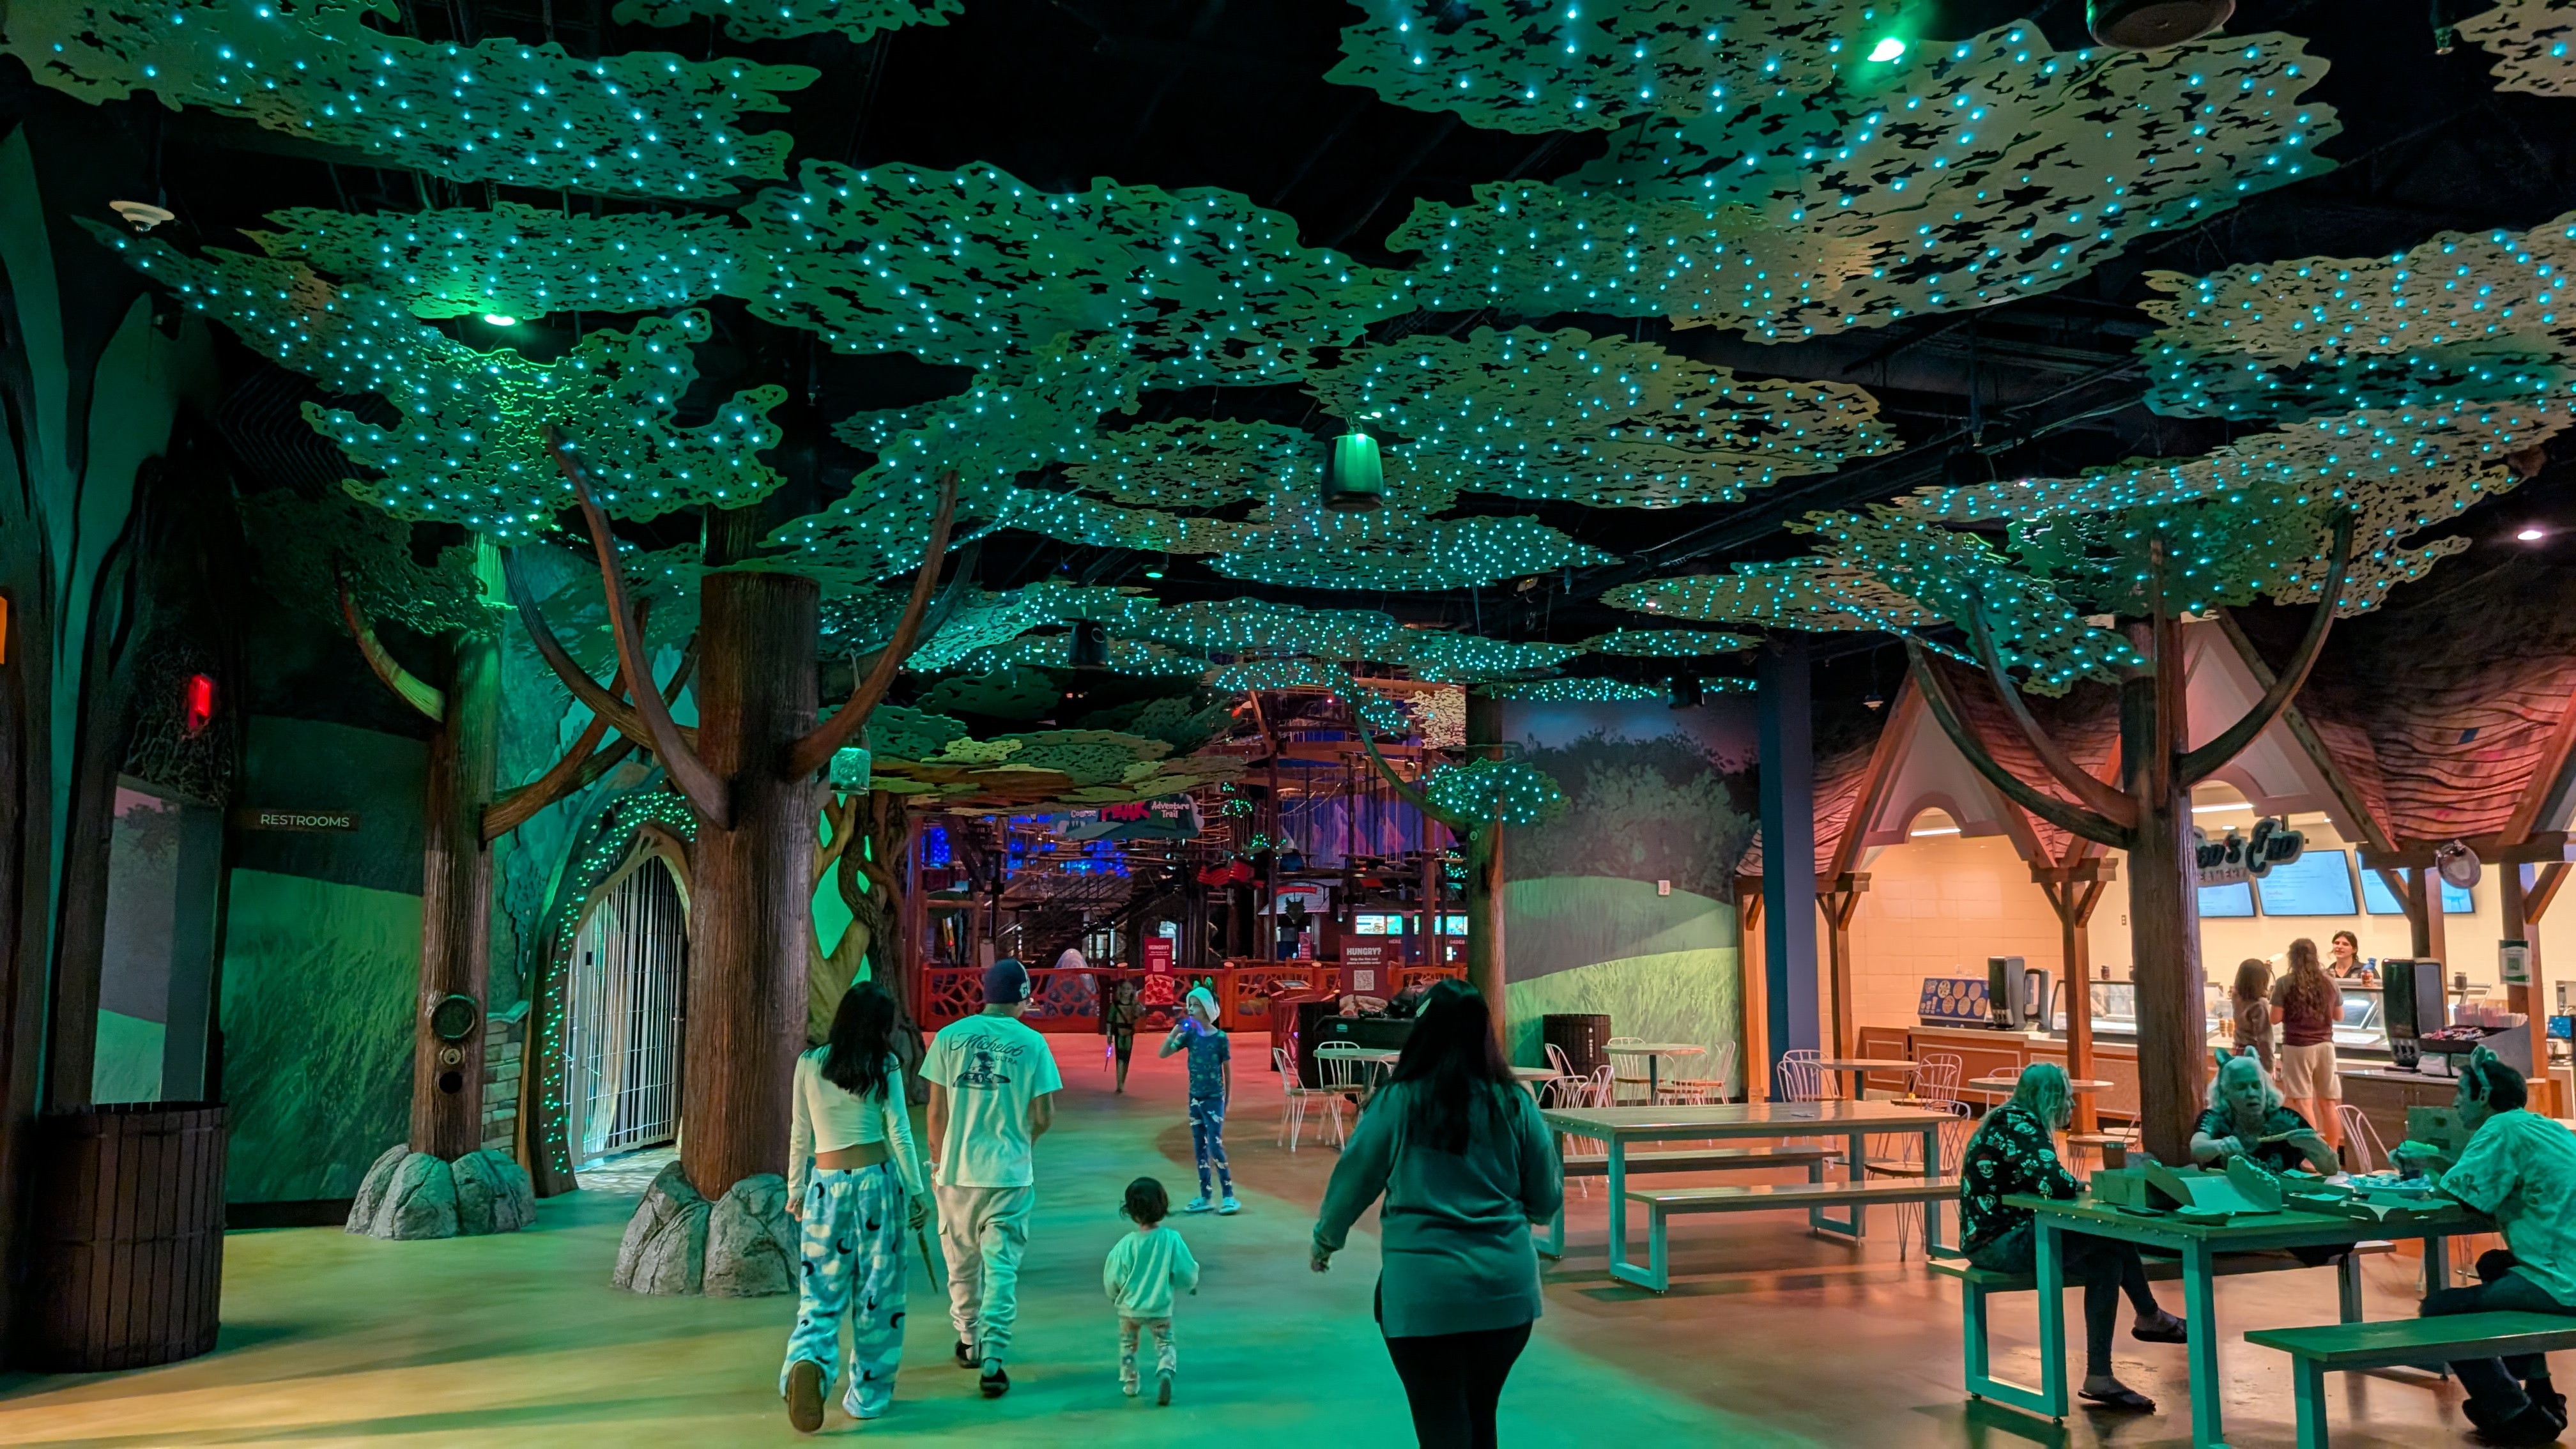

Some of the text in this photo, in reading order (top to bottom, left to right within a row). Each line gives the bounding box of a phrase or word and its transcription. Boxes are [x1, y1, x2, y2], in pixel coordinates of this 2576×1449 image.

[1151, 801, 1190, 811] Adventure
[1162, 809, 1178, 818] Trail
[260, 813, 350, 827] RESTROOMS
[1346, 947, 1381, 956] HUNGRY?
[949, 1031, 1027, 1057] Michelob
[995, 1055, 1018, 1065] ULTRA
